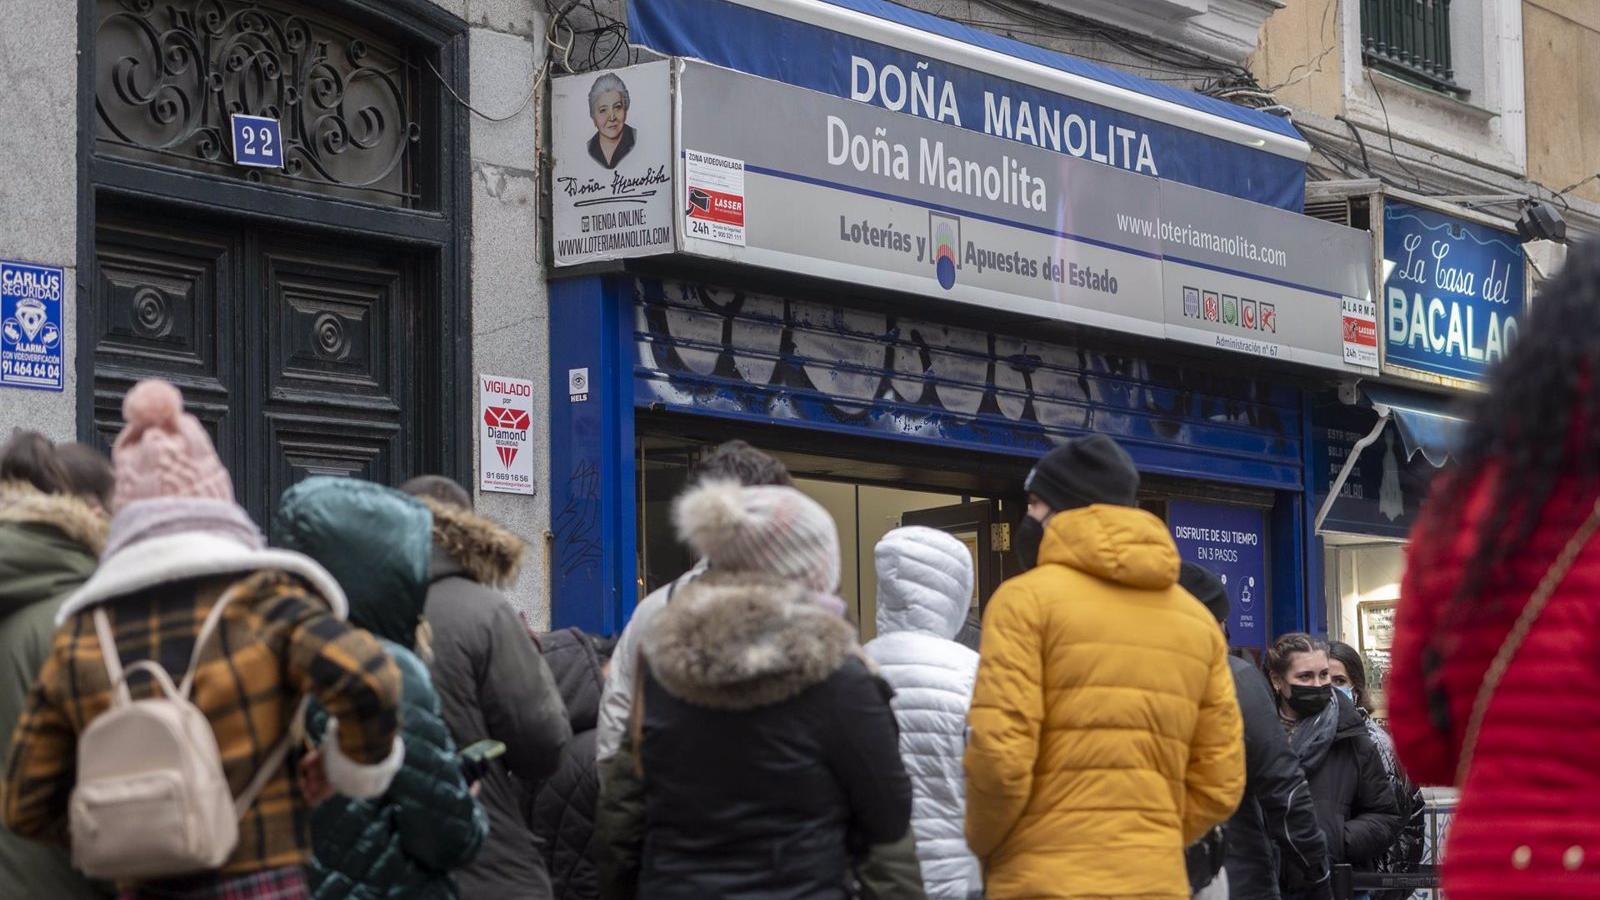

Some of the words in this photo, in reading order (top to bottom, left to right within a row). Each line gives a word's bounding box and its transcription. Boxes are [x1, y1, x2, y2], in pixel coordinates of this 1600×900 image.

[851, 55, 961, 127] DOÑA
[984, 90, 1159, 177] MANOLITA
[242, 125, 273, 157] 22
[689, 152, 703, 163] ZONA
[703, 156, 742, 170] VIDEOVIGILADA
[827, 114, 909, 181] Doña
[919, 137, 1047, 212] Manolita
[714, 198, 742, 211] LASSER
[592, 212, 617, 232] TIENDA
[618, 208, 647, 227] ONLINE:
[692, 220, 710, 236] 24h
[558, 227, 670, 257] WWW.LOTERIAMANOLITA.COM
[1117, 213, 1287, 268] www.loteriamanolita.com
[840, 215, 911, 253] Loterías
[916, 235, 926, 263] y
[965, 241, 1038, 279] Apuestas
[1042, 256, 1064, 284] del
[1069, 262, 1118, 295] Estado
[1399, 233, 1427, 284] La
[1432, 240, 1476, 297] Casa
[1482, 259, 1510, 305] del
[3, 269, 60, 290] CARLÚS
[2, 283, 60, 301] SEGURIDAD
[1342, 300, 1376, 318] ALARMA
[16, 342, 48, 354] ALARMA
[1215, 335, 1261, 353] Administración
[1269, 344, 1278, 357] 67
[3, 359, 13, 374] 91
[13, 361, 33, 376] 464
[34, 363, 47, 377] 64
[47, 364, 60, 379] 04
[483, 379, 531, 397] VIGILADO
[502, 397, 512, 405] por
[486, 471, 495, 480] 91
[510, 473, 519, 482] 16
[1175, 525, 1210, 541] DISFRUTE
[1210, 529, 1220, 542] DE
[1220, 530, 1231, 544] SU
[1231, 531, 1258, 546] TIEMPO
[1197, 546, 1208, 560] EN
[1208, 548, 1214, 560] 3
[1215, 549, 1238, 562] PASOS
